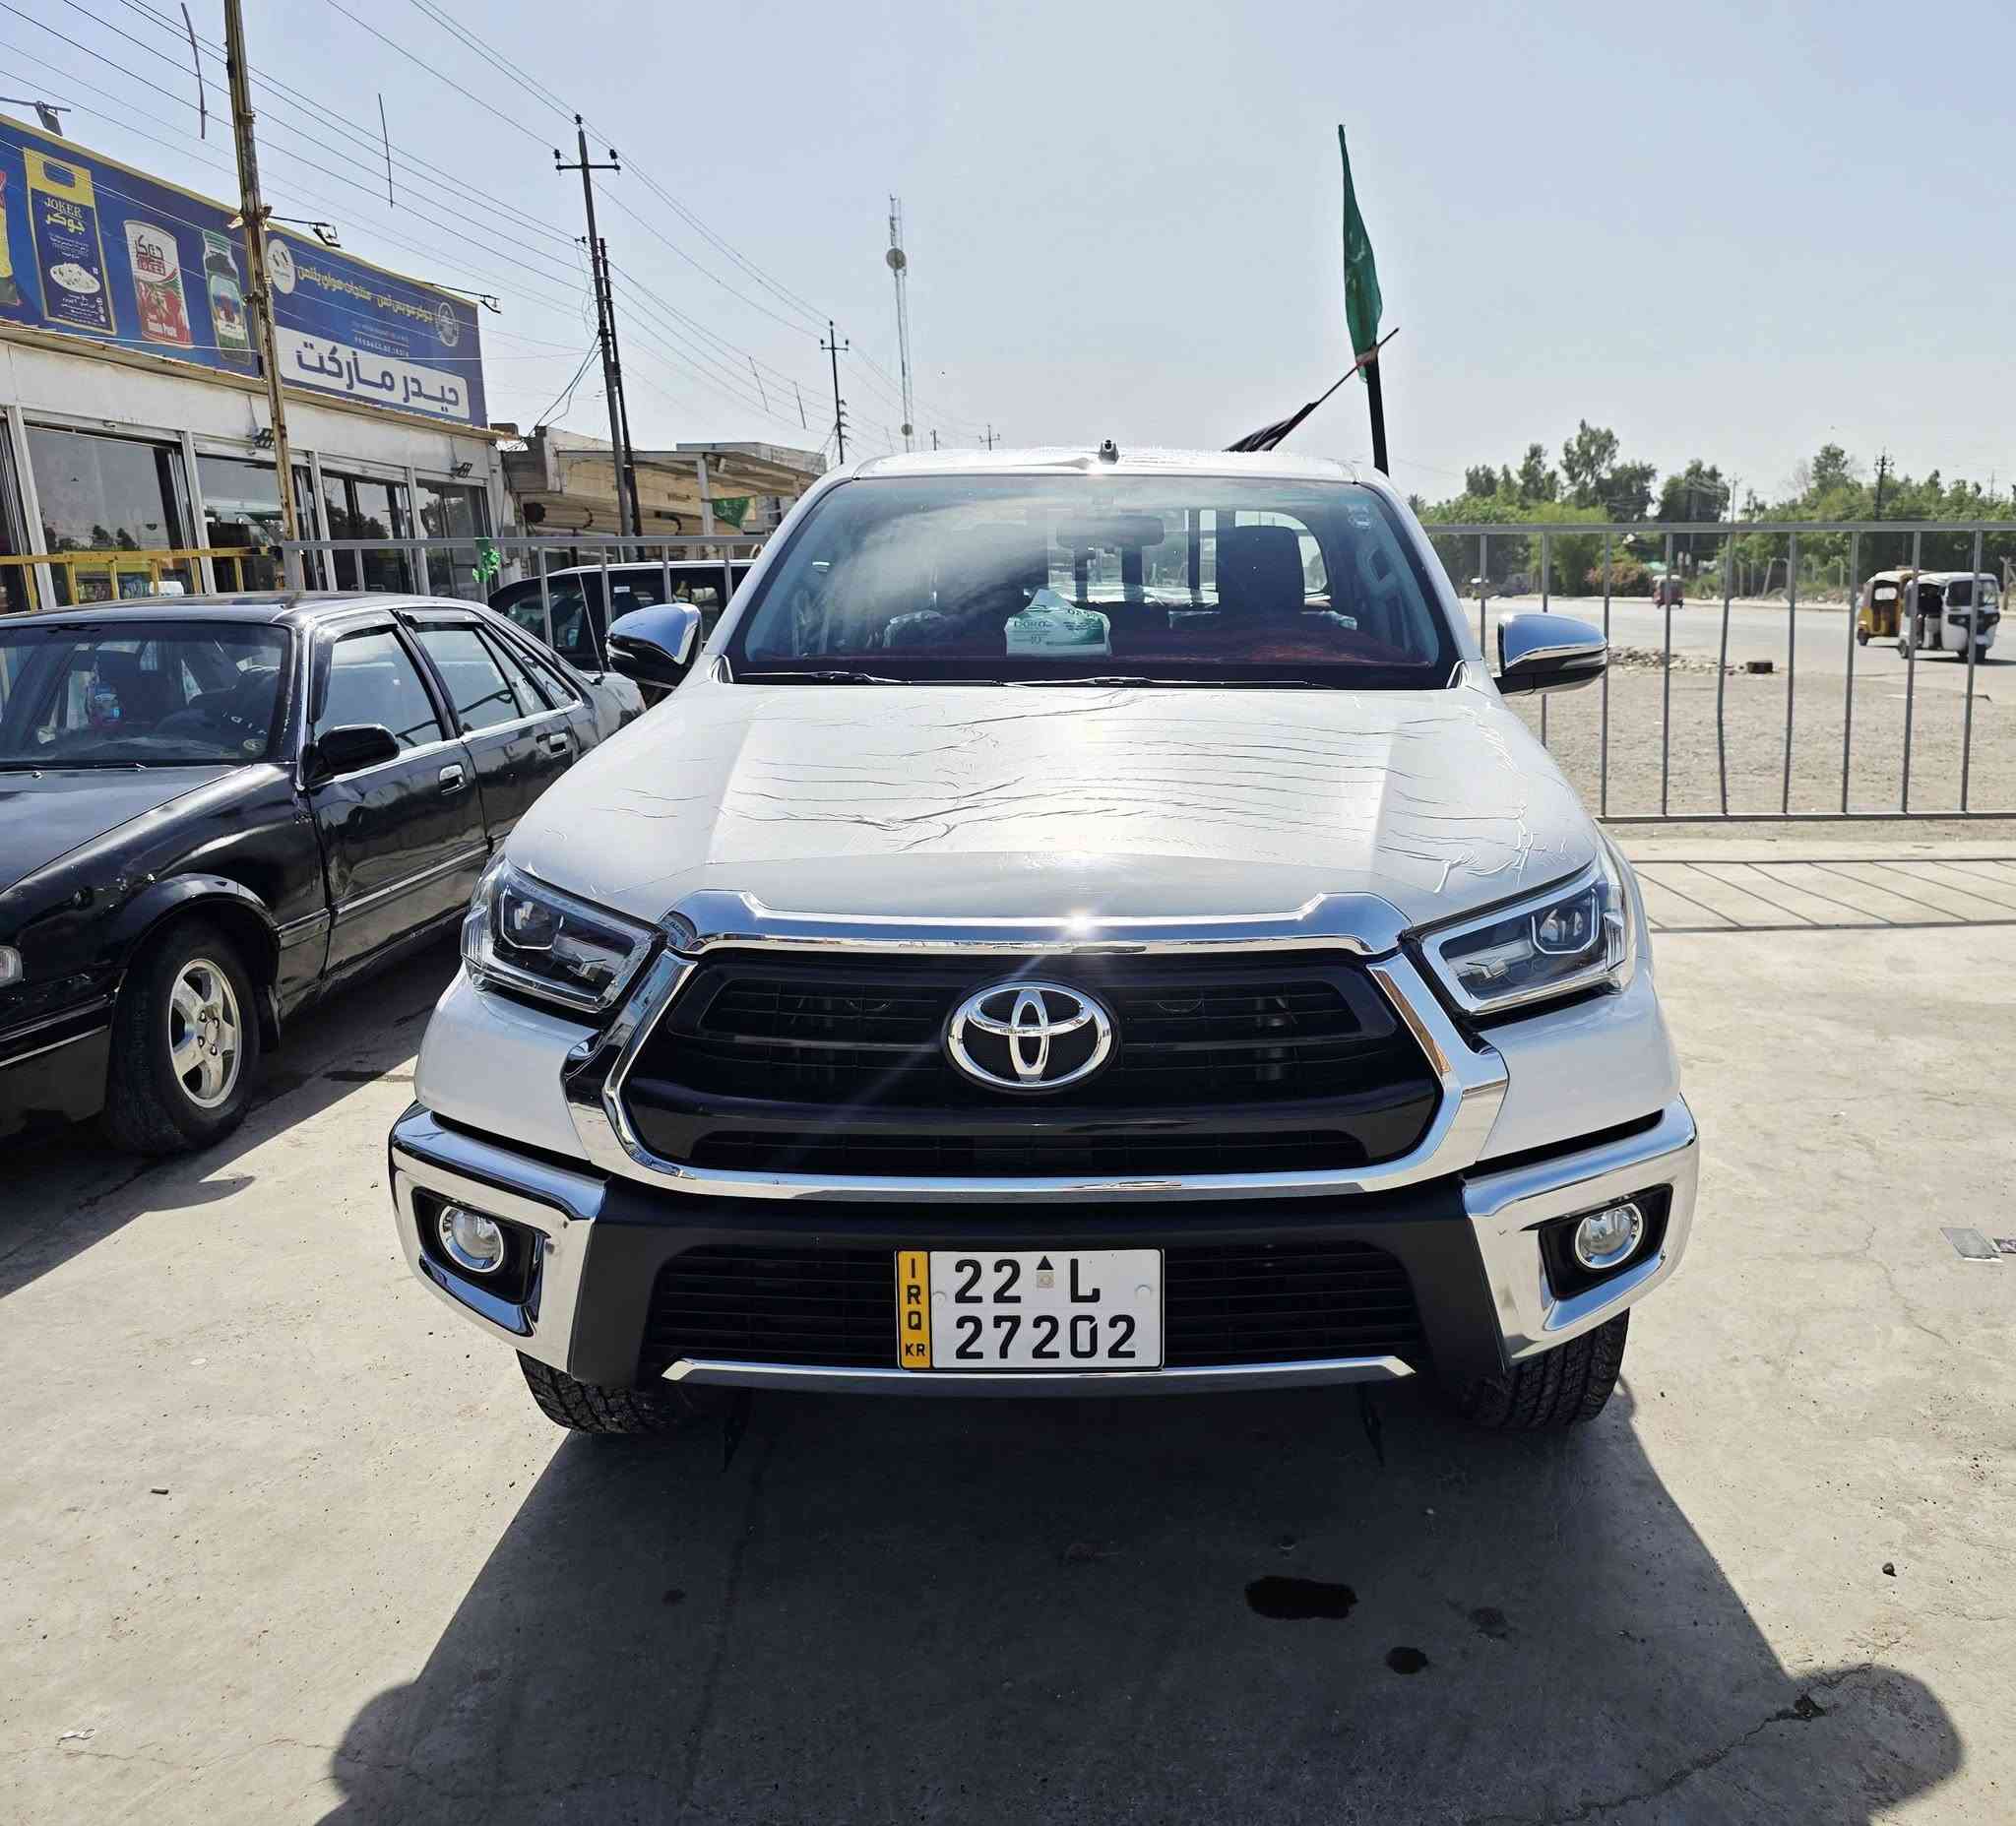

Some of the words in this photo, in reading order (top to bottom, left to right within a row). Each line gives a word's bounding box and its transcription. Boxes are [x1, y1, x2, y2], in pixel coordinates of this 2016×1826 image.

[44, 197, 84, 219] JOKER
[403, 375, 459, 412] حيدر
[954, 1258, 1022, 1304] 22
[1069, 1258, 1101, 1303] L
[905, 1343, 926, 1356] KR
[955, 1314, 1136, 1359] 27202
